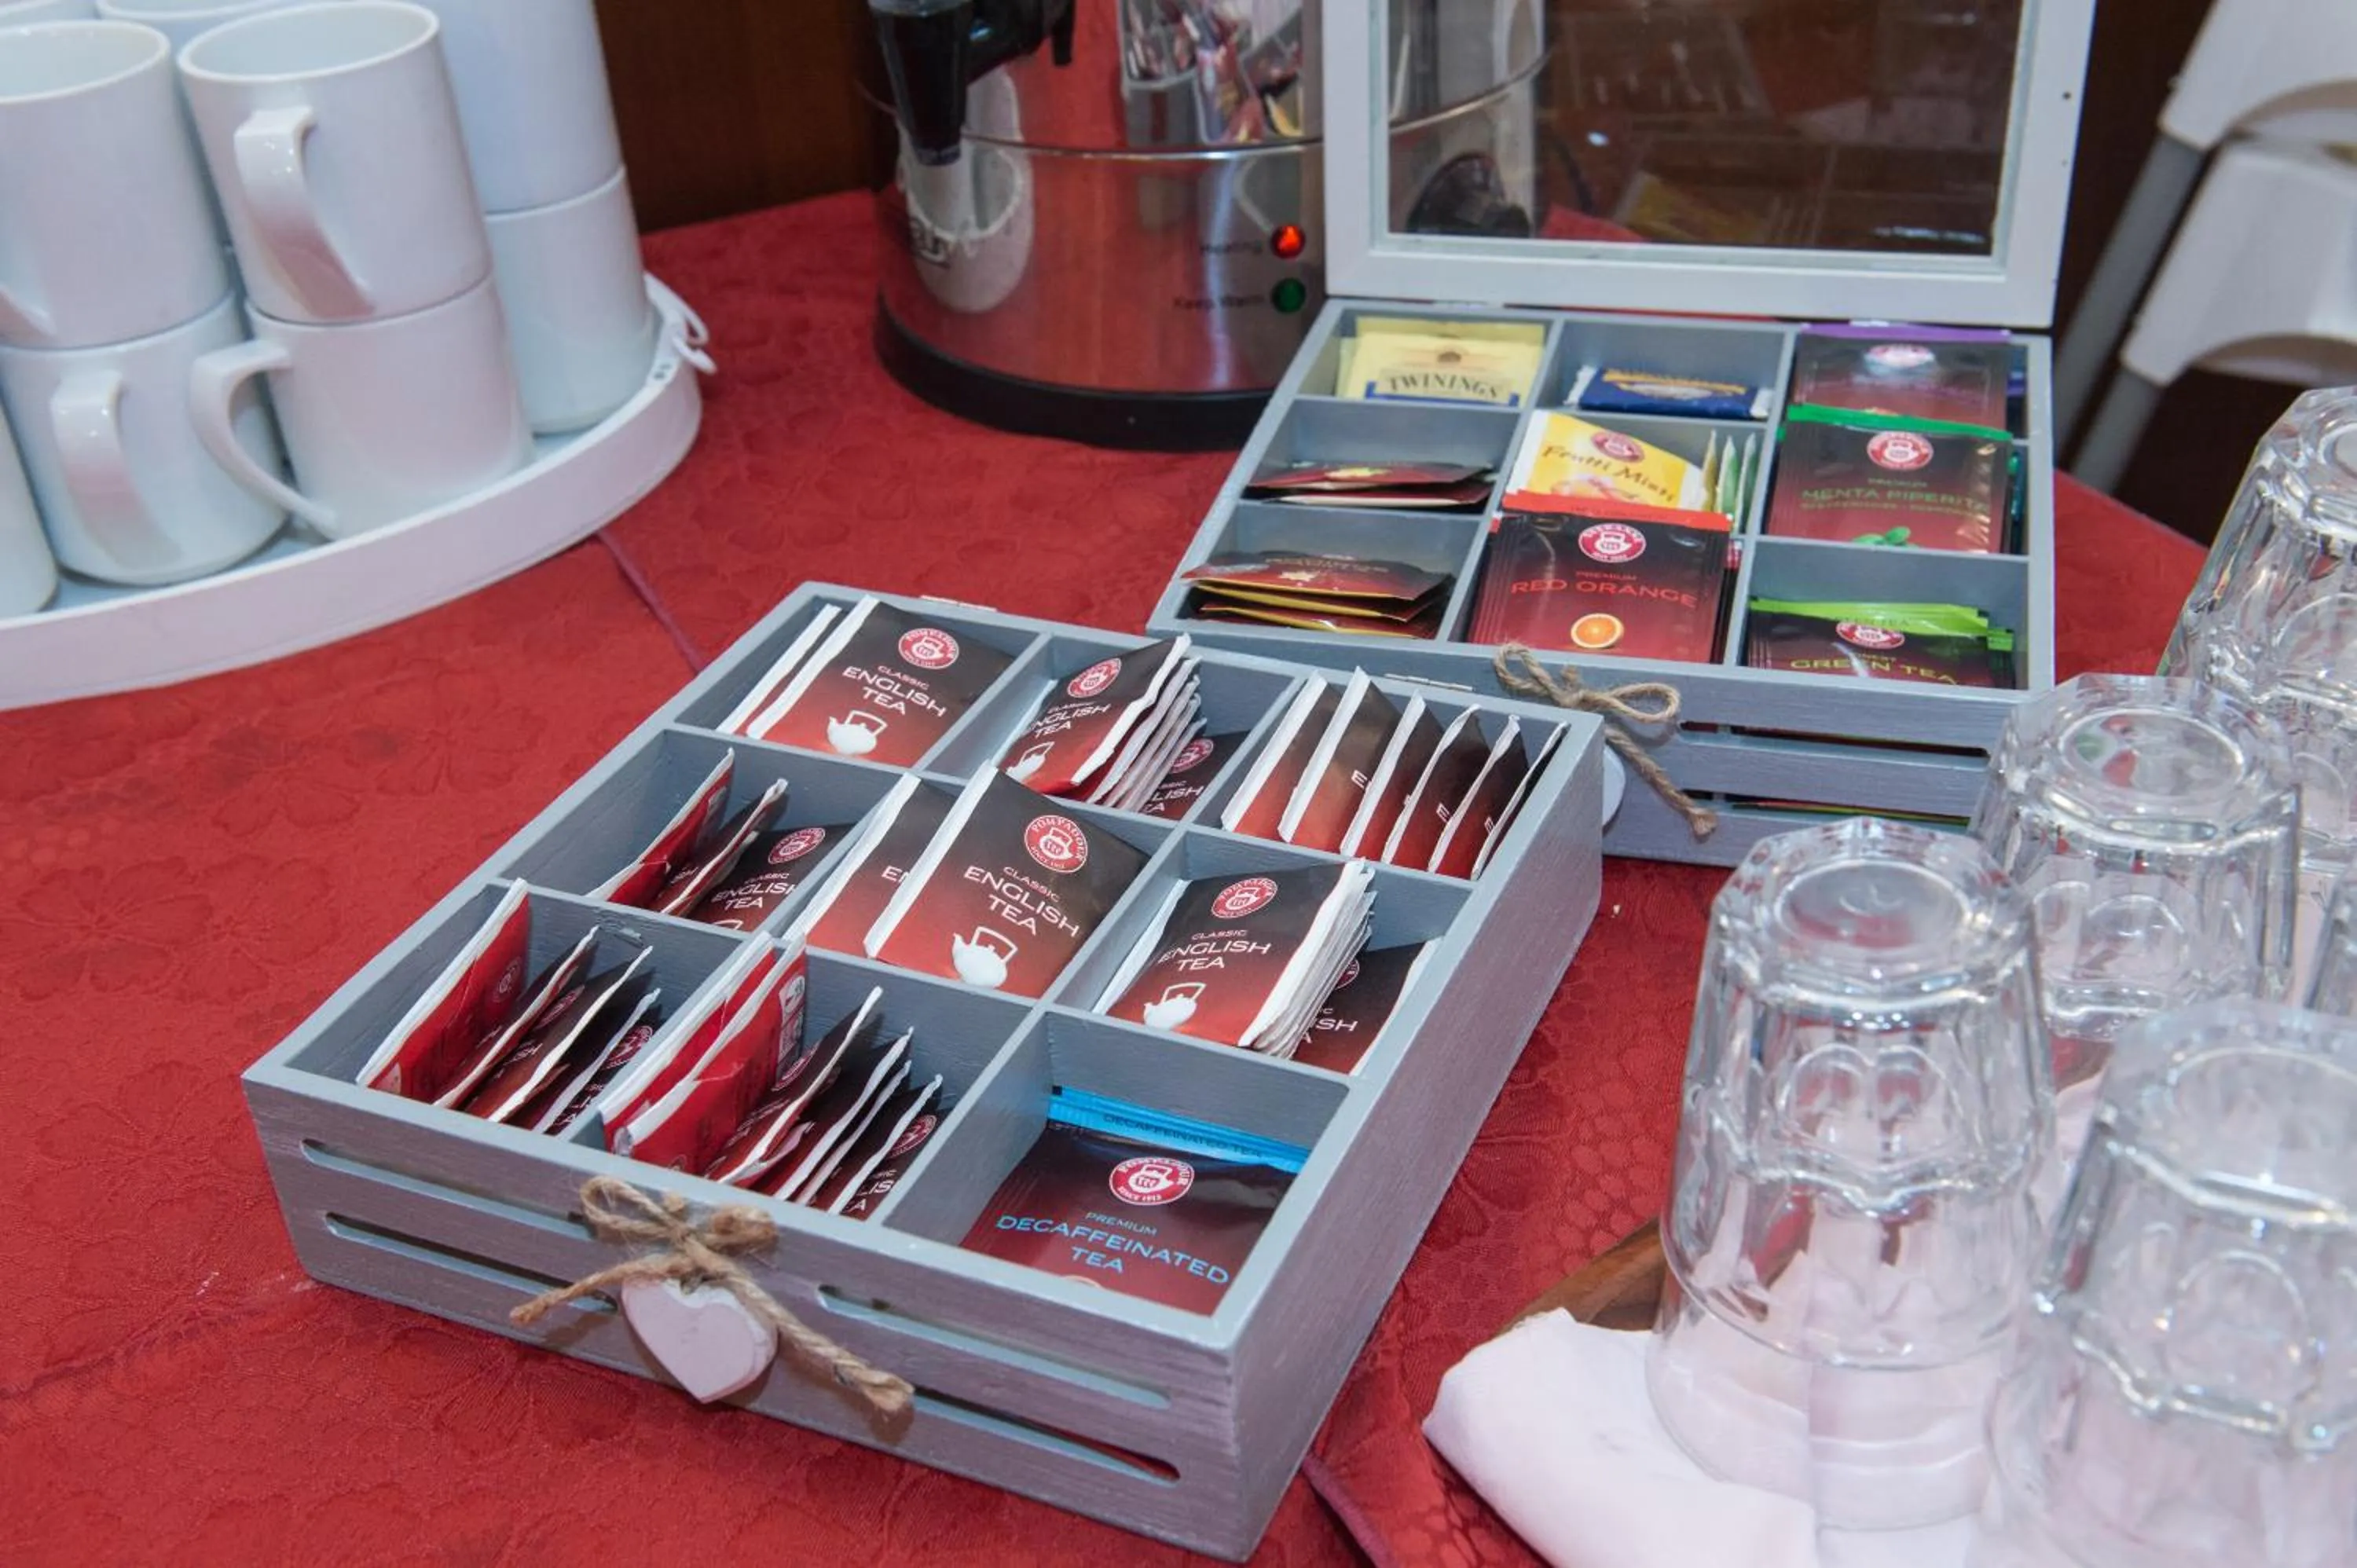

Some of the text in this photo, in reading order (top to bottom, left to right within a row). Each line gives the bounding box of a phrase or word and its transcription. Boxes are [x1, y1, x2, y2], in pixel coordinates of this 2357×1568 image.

[1388, 372, 1497, 398] TWININGS
[1802, 488, 1879, 501] MENTA
[1574, 570, 1638, 581] PREMIUM
[1511, 578, 1698, 608] RED ORANGE
[878, 665, 929, 691] CLASSIC
[842, 666, 947, 717] ENGLISH
[862, 686, 906, 716] TEA
[1034, 720, 1071, 738] TEA
[1003, 866, 1061, 903] CLASSIC
[724, 896, 764, 911] TEA
[963, 865, 1080, 937] ENGLISH
[988, 894, 1037, 936] TEA
[1191, 929, 1248, 940] CLASSIC
[1157, 940, 1272, 964] ENGLISH
[1177, 956, 1226, 973] TEA
[1102, 1112, 1227, 1150] DECAFFEINATED
[1084, 1211, 1157, 1236] PREMIUM
[995, 1214, 1230, 1285] DECAFFEINATED
[1070, 1246, 1124, 1273] TEA
